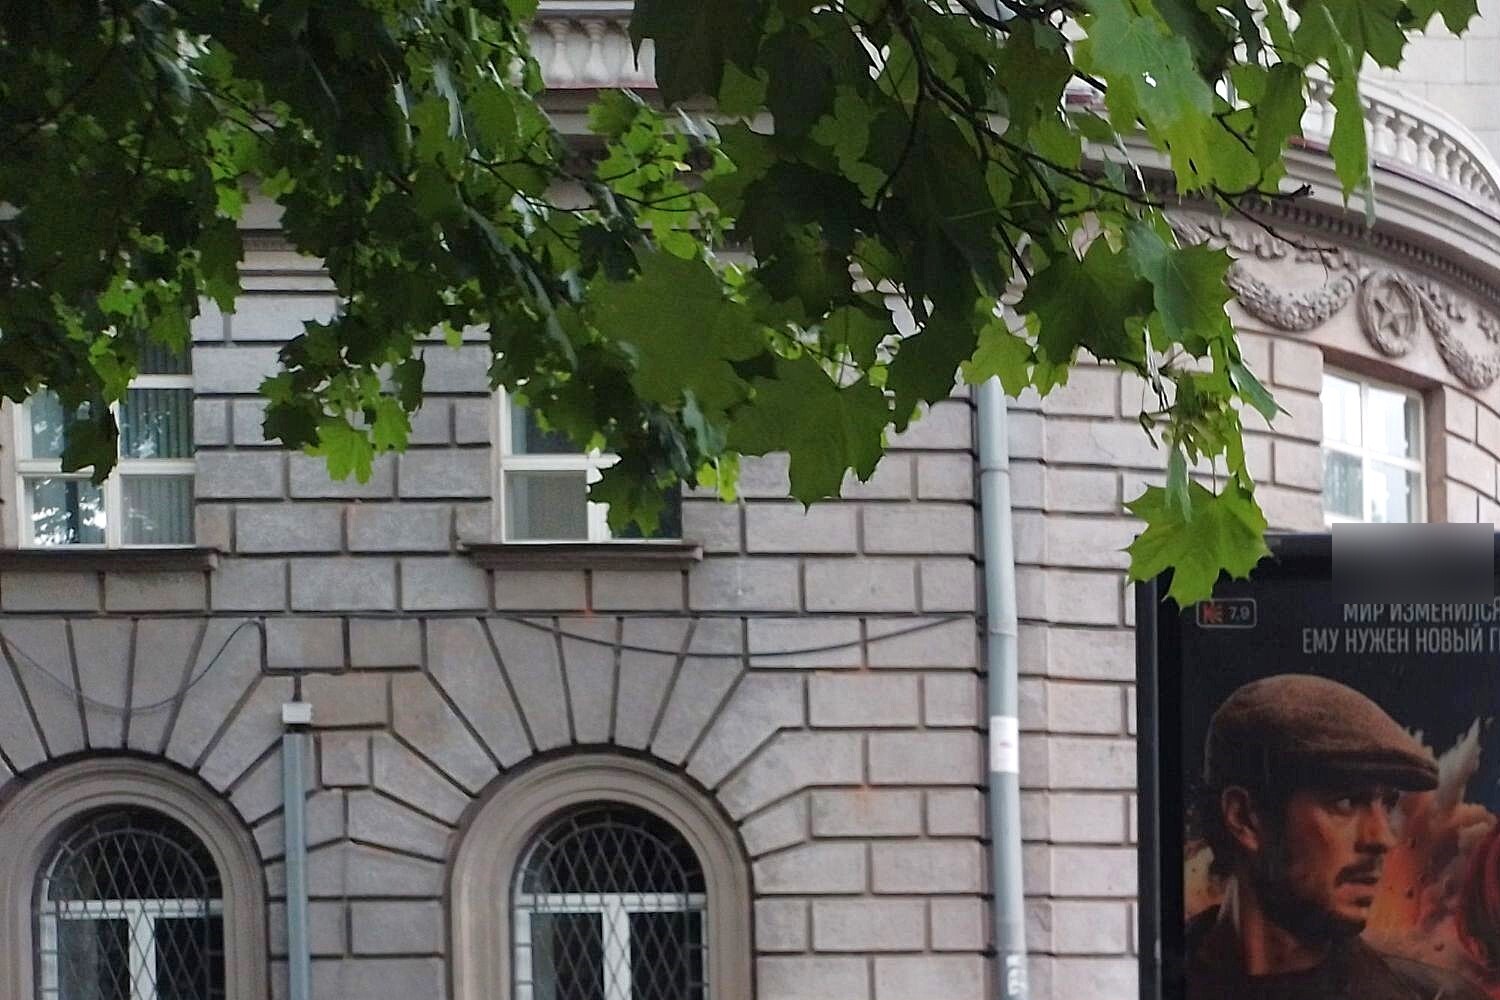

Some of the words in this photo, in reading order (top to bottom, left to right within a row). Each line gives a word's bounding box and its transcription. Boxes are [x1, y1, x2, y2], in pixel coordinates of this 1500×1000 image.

[1344, 603, 1384, 622] МИР
[1302, 628, 1338, 654] ЕМУ
[1345, 627, 1409, 654] НУЖЕН
[1415, 623, 1482, 654] НОВЫЙ
